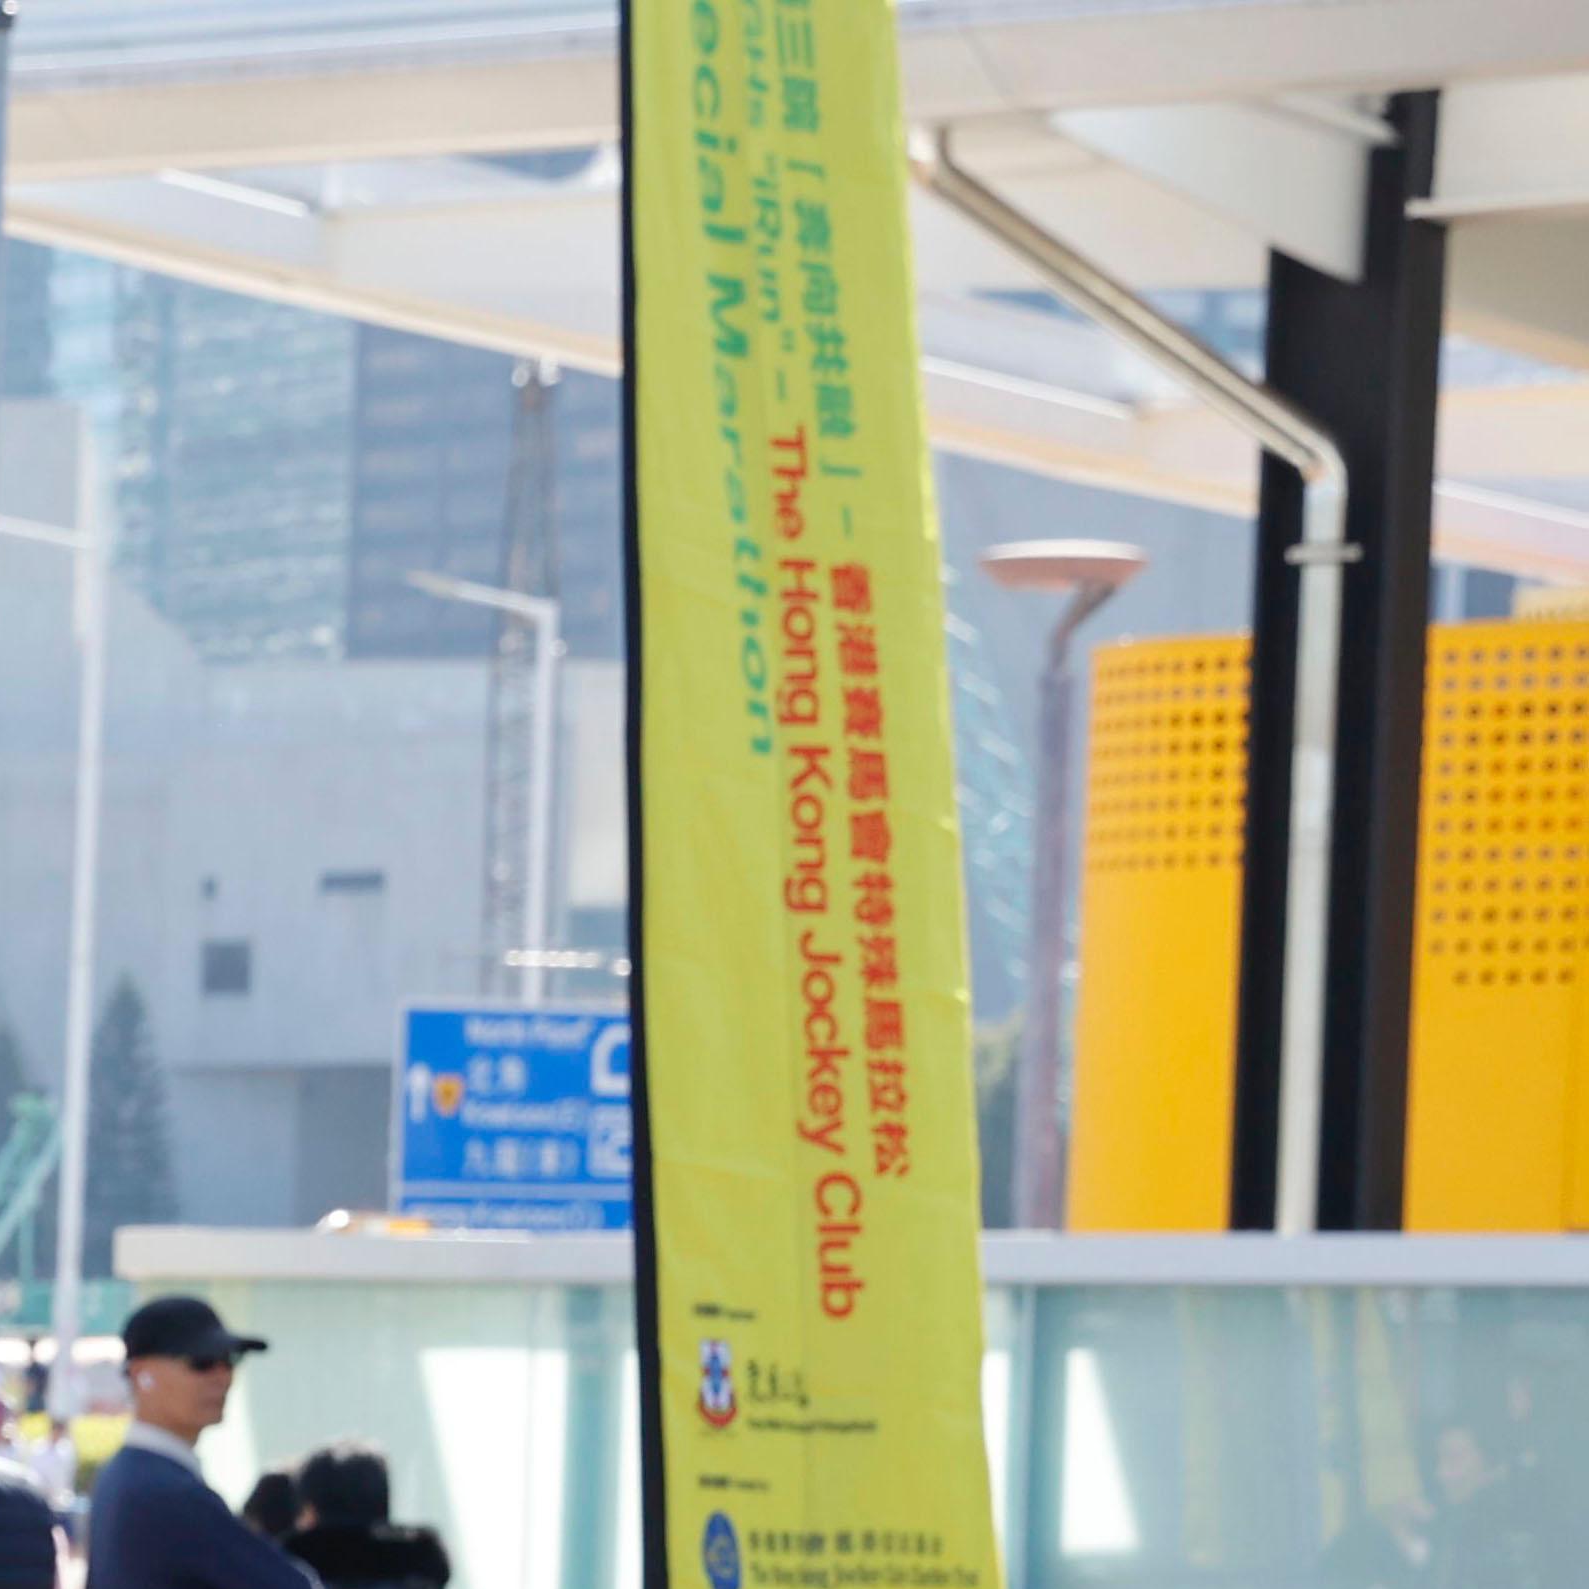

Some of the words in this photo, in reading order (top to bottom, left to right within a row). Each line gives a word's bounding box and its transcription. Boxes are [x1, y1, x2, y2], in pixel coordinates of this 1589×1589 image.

[707, 271, 774, 755] Marathon
[770, 424, 808, 540] The
[776, 558, 820, 726] Hong
[783, 745, 834, 914] Kong
[796, 930, 851, 1157] Jockey
[813, 1171, 865, 1319] Club
